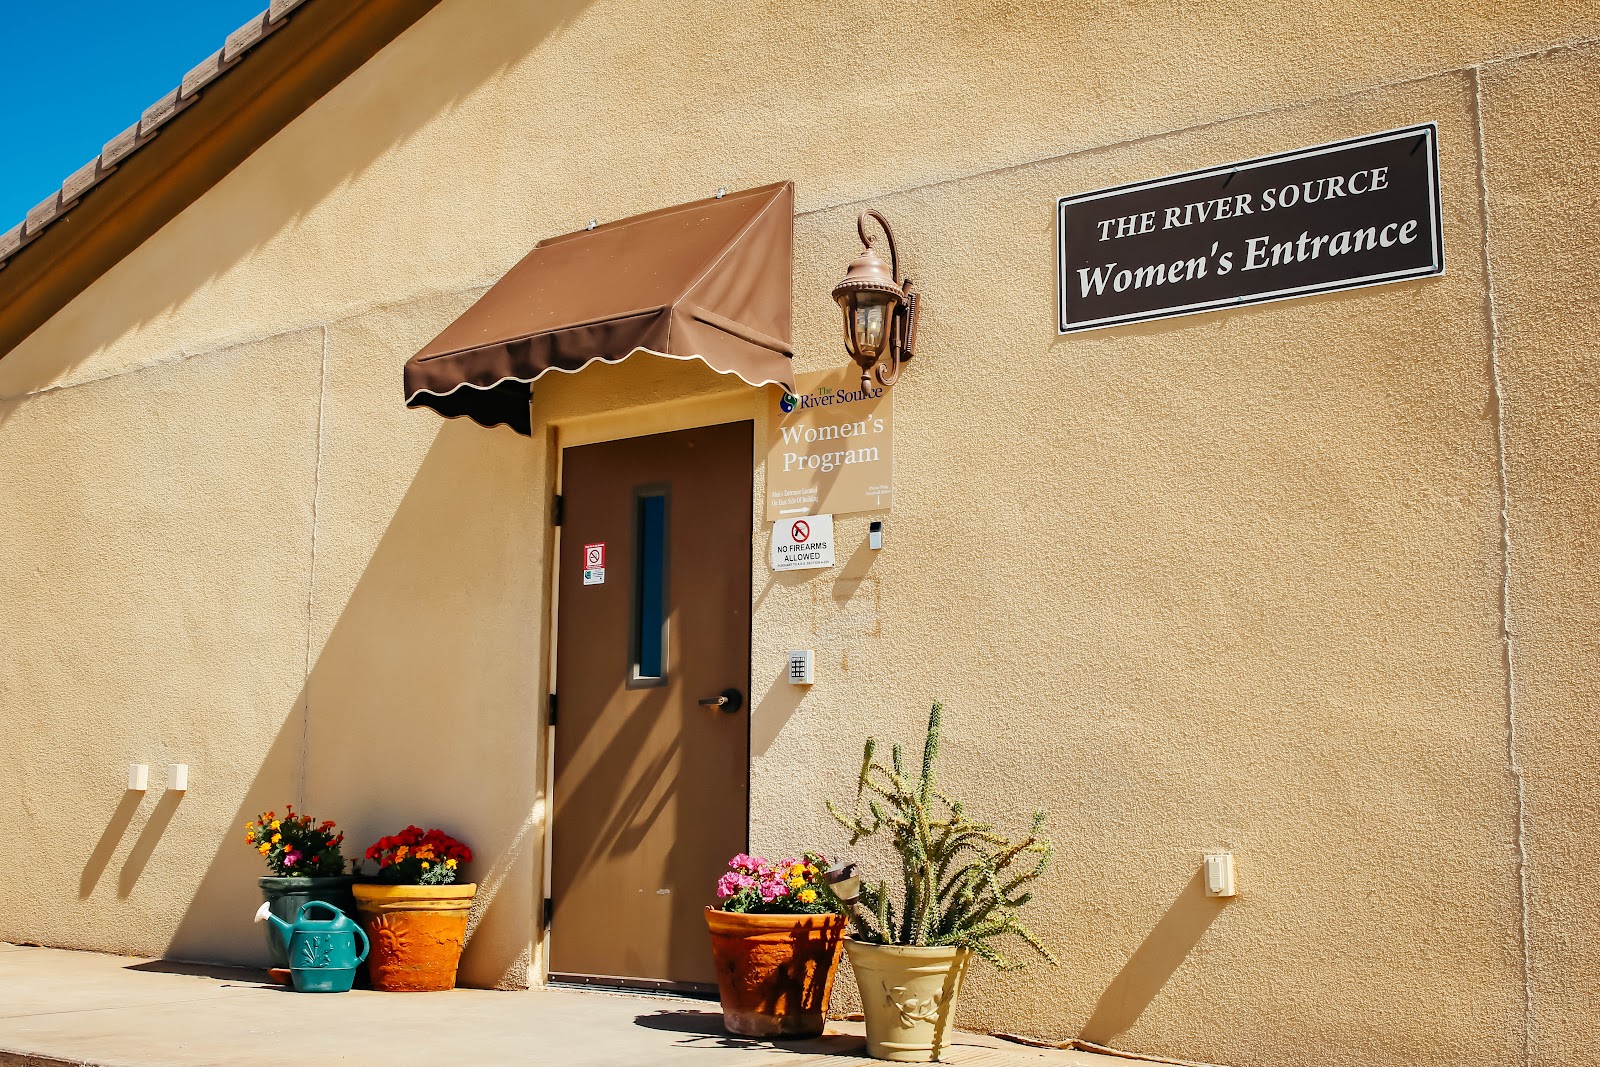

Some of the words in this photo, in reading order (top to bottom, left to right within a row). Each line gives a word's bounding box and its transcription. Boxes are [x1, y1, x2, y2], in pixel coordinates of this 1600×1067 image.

[1097, 211, 1156, 242] THE
[1162, 194, 1254, 231] RIVER
[1260, 166, 1389, 211] SOURCE
[1077, 241, 1233, 299] Women's
[1240, 218, 1418, 272] Entrance
[800, 394, 835, 409] River
[836, 387, 883, 404] Souce
[818, 387, 832, 395] The
[780, 414, 884, 446] Women's
[782, 447, 880, 473] Program
[802, 486, 818, 494] Located
[777, 545, 788, 553] NO
[789, 542, 827, 552] FIREARMS
[784, 552, 820, 562] ALLOWED
